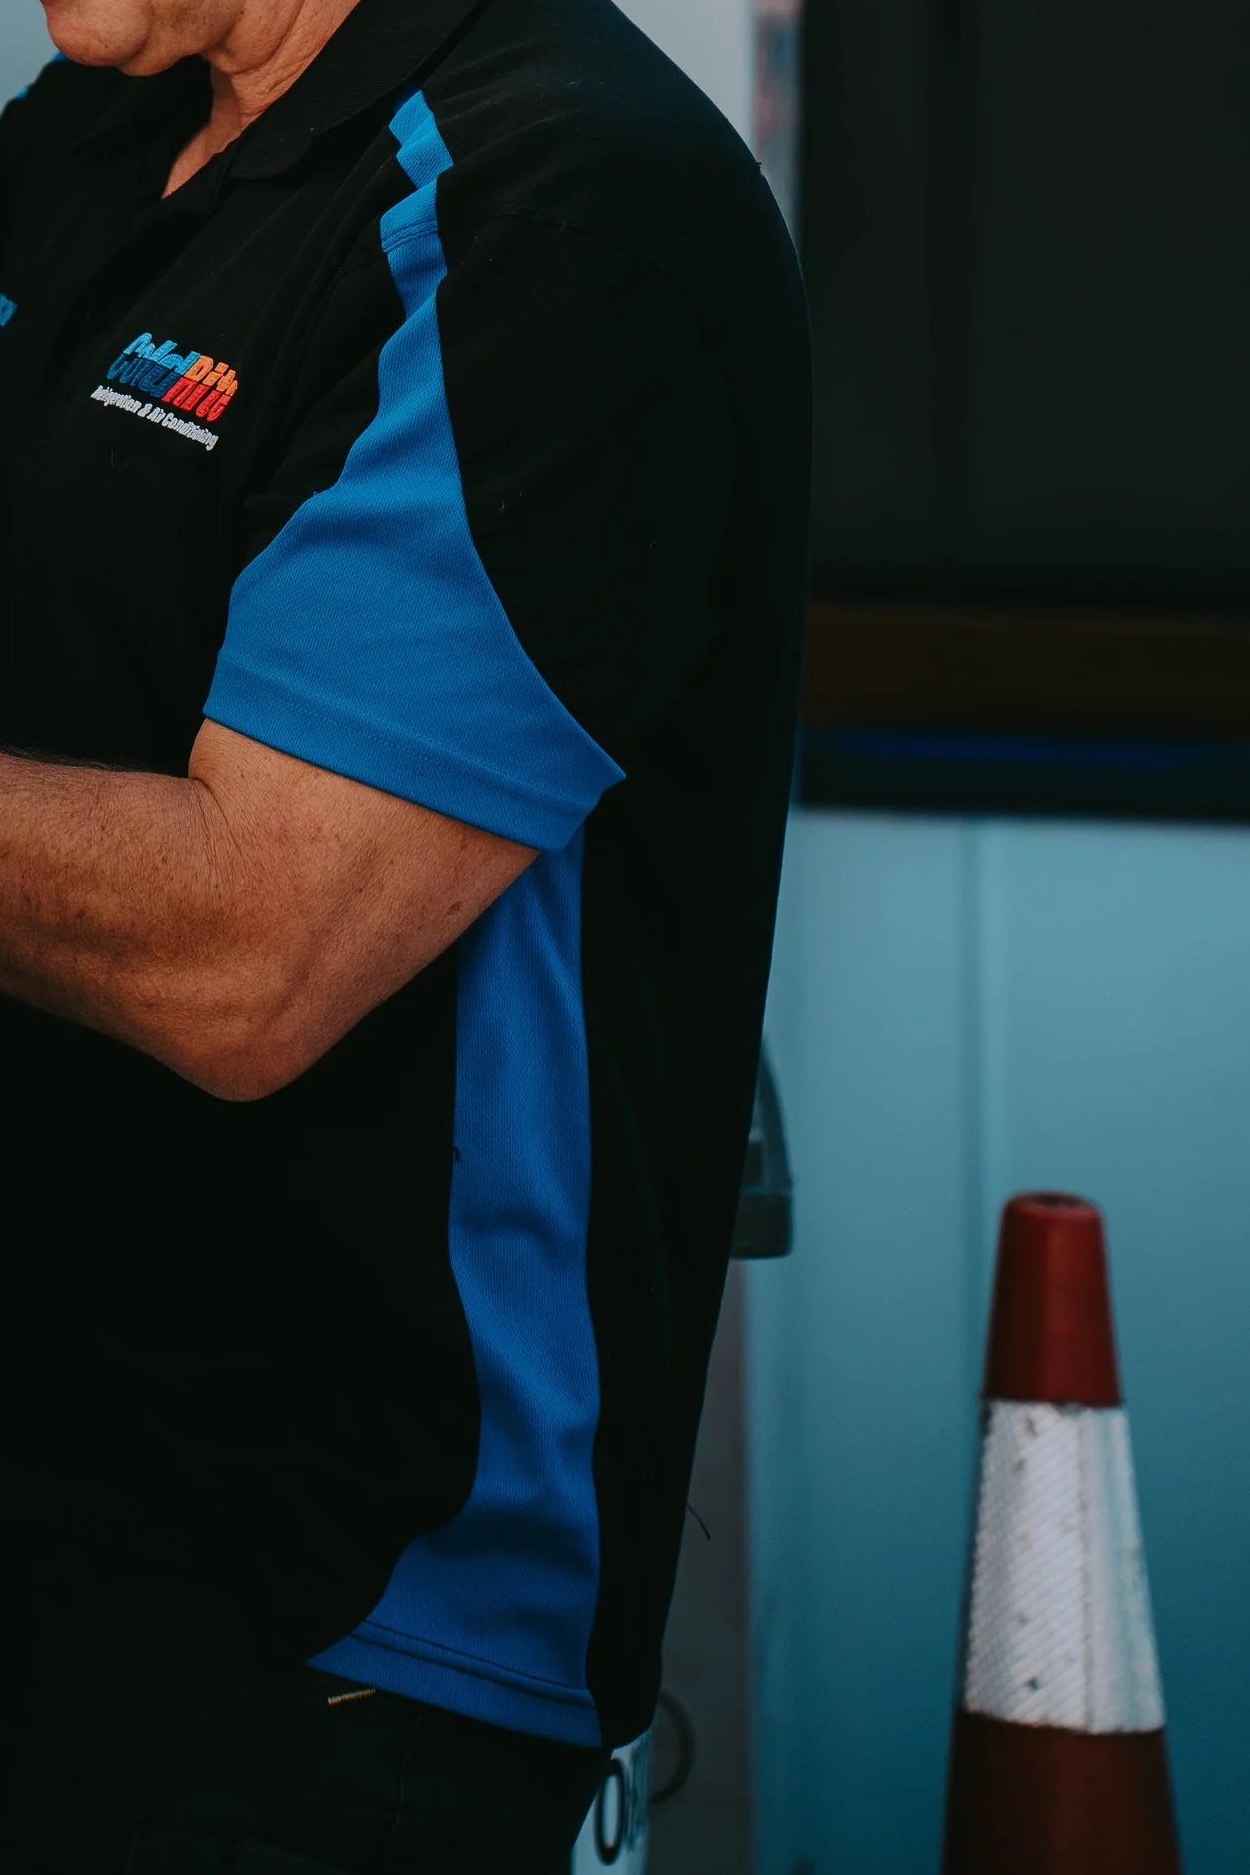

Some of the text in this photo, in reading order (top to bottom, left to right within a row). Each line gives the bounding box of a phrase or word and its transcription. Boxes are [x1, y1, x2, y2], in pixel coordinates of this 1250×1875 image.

[137, 403, 153, 418] &
[146, 406, 166, 423] Air
[161, 412, 219, 451] Conditioning
